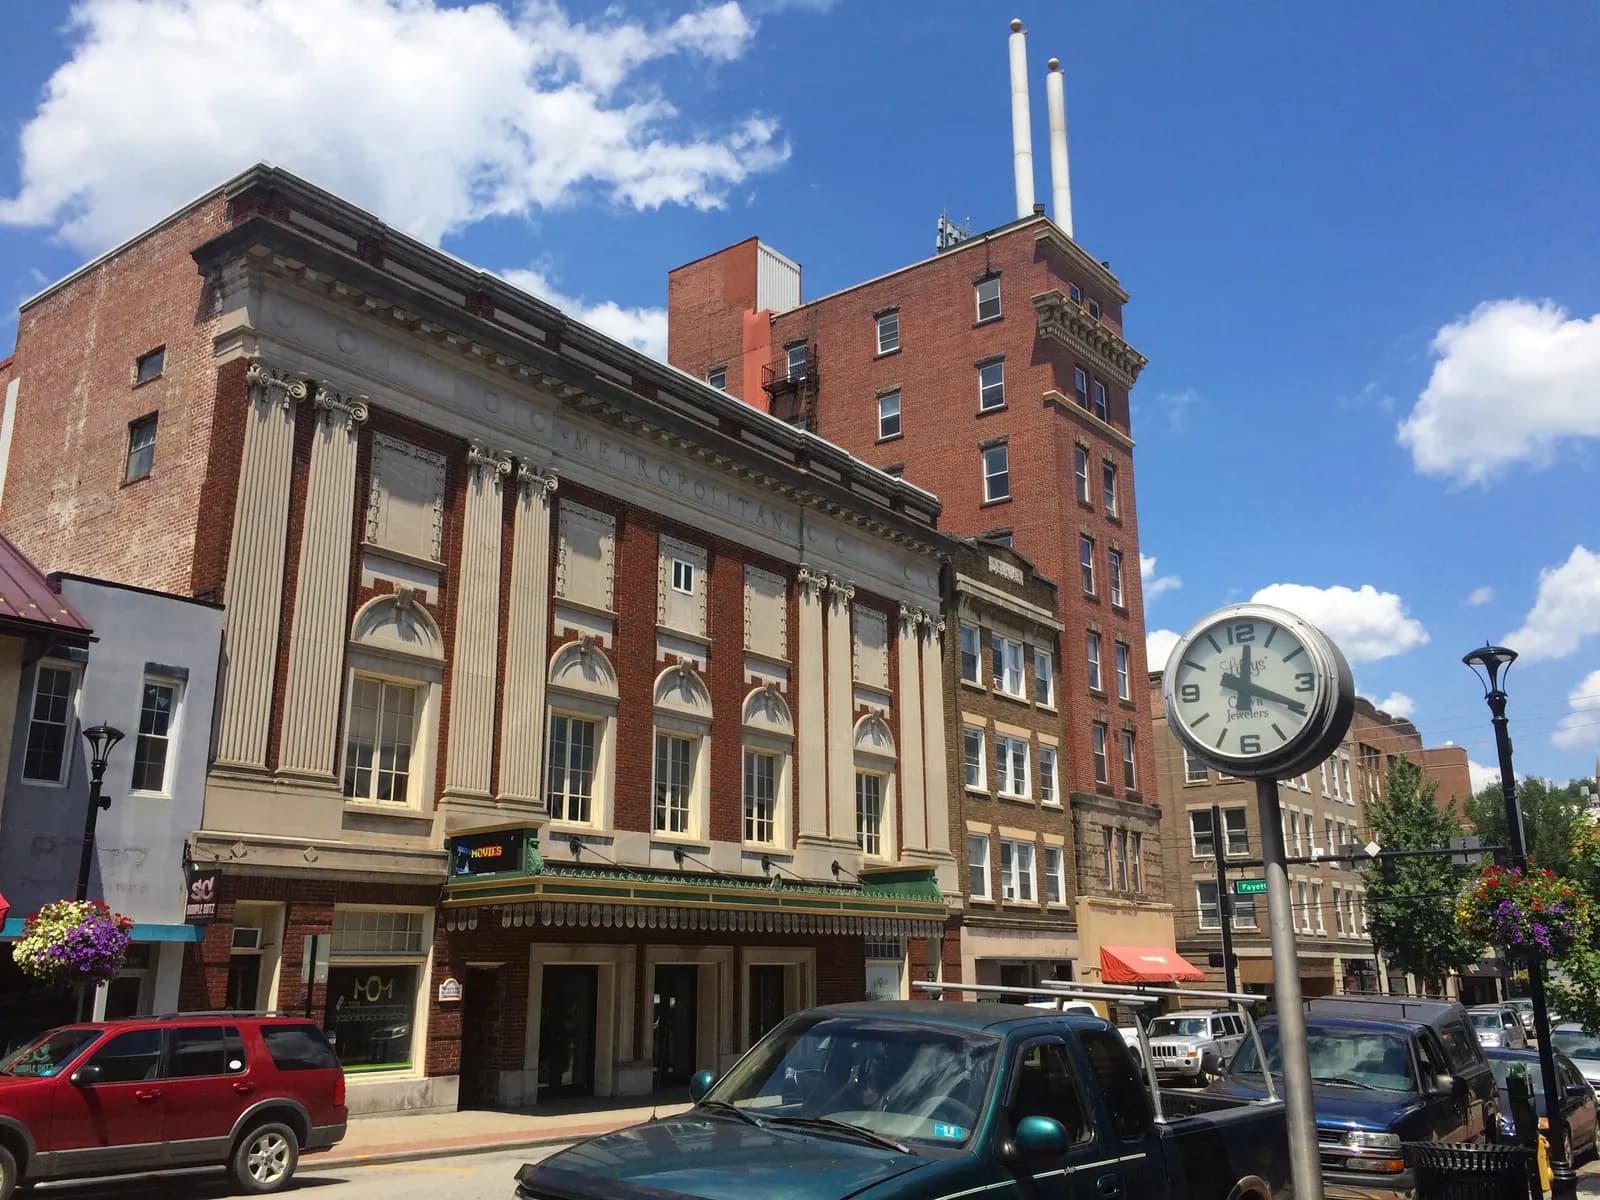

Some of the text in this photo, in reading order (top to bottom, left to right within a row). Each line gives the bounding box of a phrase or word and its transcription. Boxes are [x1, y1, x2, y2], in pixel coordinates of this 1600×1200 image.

[574, 430, 784, 531] METROPOLITAN
[1226, 623, 1255, 645] 12
[1295, 672, 1315, 692] 3
[1182, 684, 1200, 703] 9
[1226, 709, 1270, 723] Jewelers
[1240, 734, 1261, 754] 6
[471, 845, 502, 858] MOVIES
